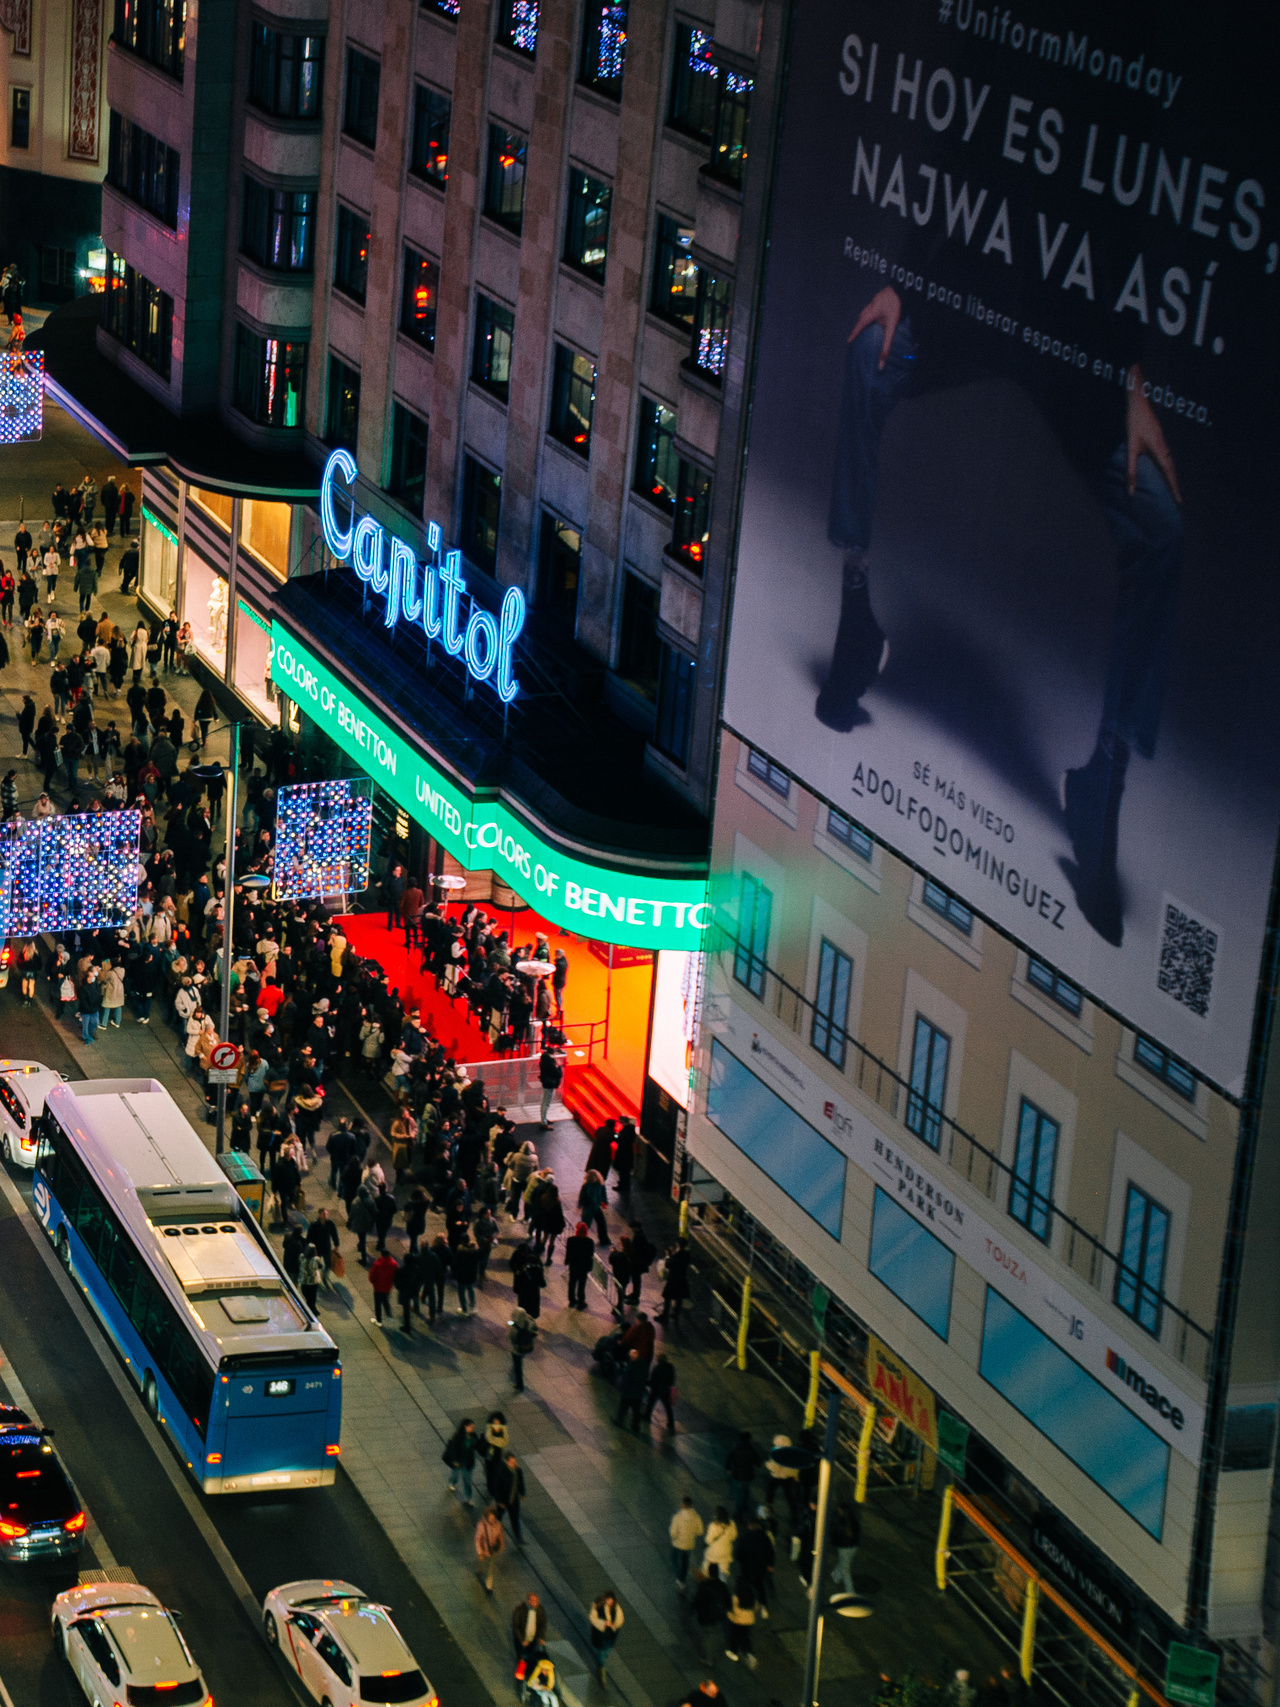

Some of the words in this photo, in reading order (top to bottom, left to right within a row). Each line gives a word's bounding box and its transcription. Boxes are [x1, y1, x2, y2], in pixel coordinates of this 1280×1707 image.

[939, 0, 1183, 108] #UniformMonday
[839, 33, 878, 102] SI
[891, 53, 990, 142] HOY
[1002, 95, 1065, 175] ES
[1080, 124, 1279, 274] LUNES,
[852, 136, 1013, 265] NAJWA
[1038, 212, 1095, 300] VA
[1114, 252, 1225, 355] ASÍ.
[843, 236, 888, 274] Repite
[891, 263, 924, 291] ropa
[927, 281, 962, 310] para
[966, 295, 1019, 336] liberar
[1022, 326, 1088, 368] espacio
[1093, 358, 1114, 382] en
[1119, 366, 1136, 391] tu
[320, 448, 526, 703] Capitol
[277, 644, 319, 701] COLORS
[320, 686, 337, 716] OF
[337, 701, 398, 776] BENETTON
[415, 774, 462, 836] UNITED
[464, 822, 531, 879] COLORS
[534, 863, 560, 897] OF
[913, 761, 931, 786] SÉ
[935, 775, 967, 811] MÁS
[971, 800, 1015, 843] VIEJO
[874, 1137, 966, 1226] HENDERSON
[897, 1178, 936, 1222] PARK
[985, 1237, 1028, 1286] TOUZA
[1125, 1365, 1185, 1431] mace
